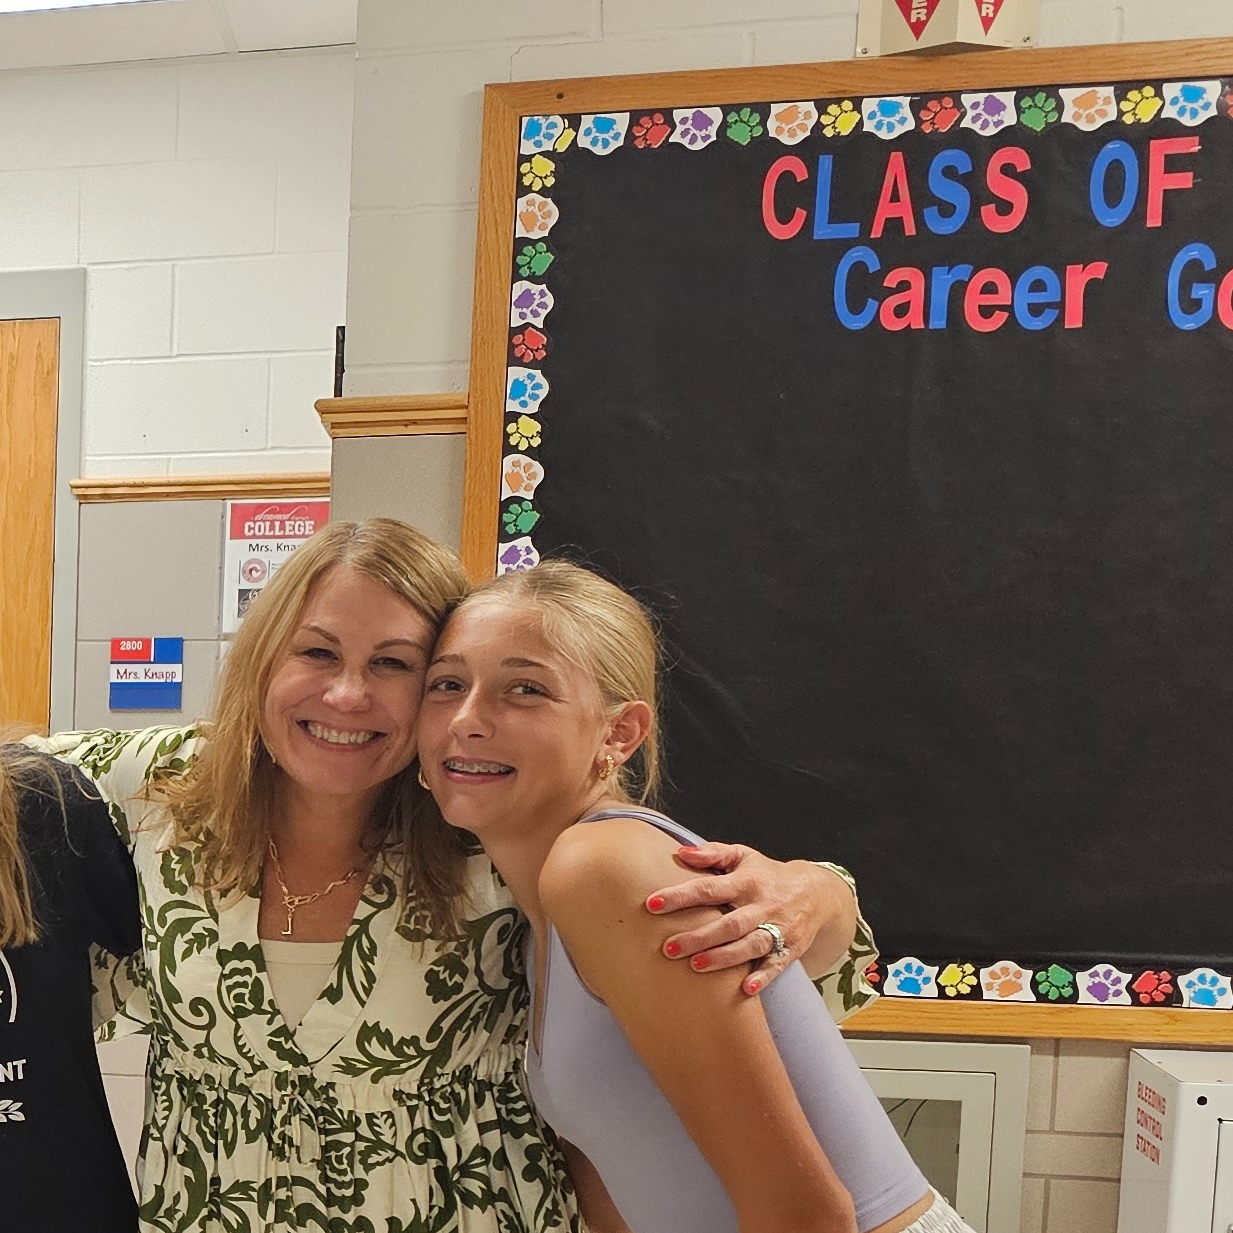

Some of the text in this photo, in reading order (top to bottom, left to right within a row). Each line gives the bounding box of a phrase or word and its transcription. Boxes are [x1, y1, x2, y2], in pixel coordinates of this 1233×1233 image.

[762, 136, 1200, 240] CLASS OF
[833, 245, 1109, 332] Career
[244, 520, 314, 536] COLLEGE
[248, 543, 273, 552] Mrs.
[120, 641, 143, 651] 2800
[116, 668, 177, 683] Mrs. Knapp
